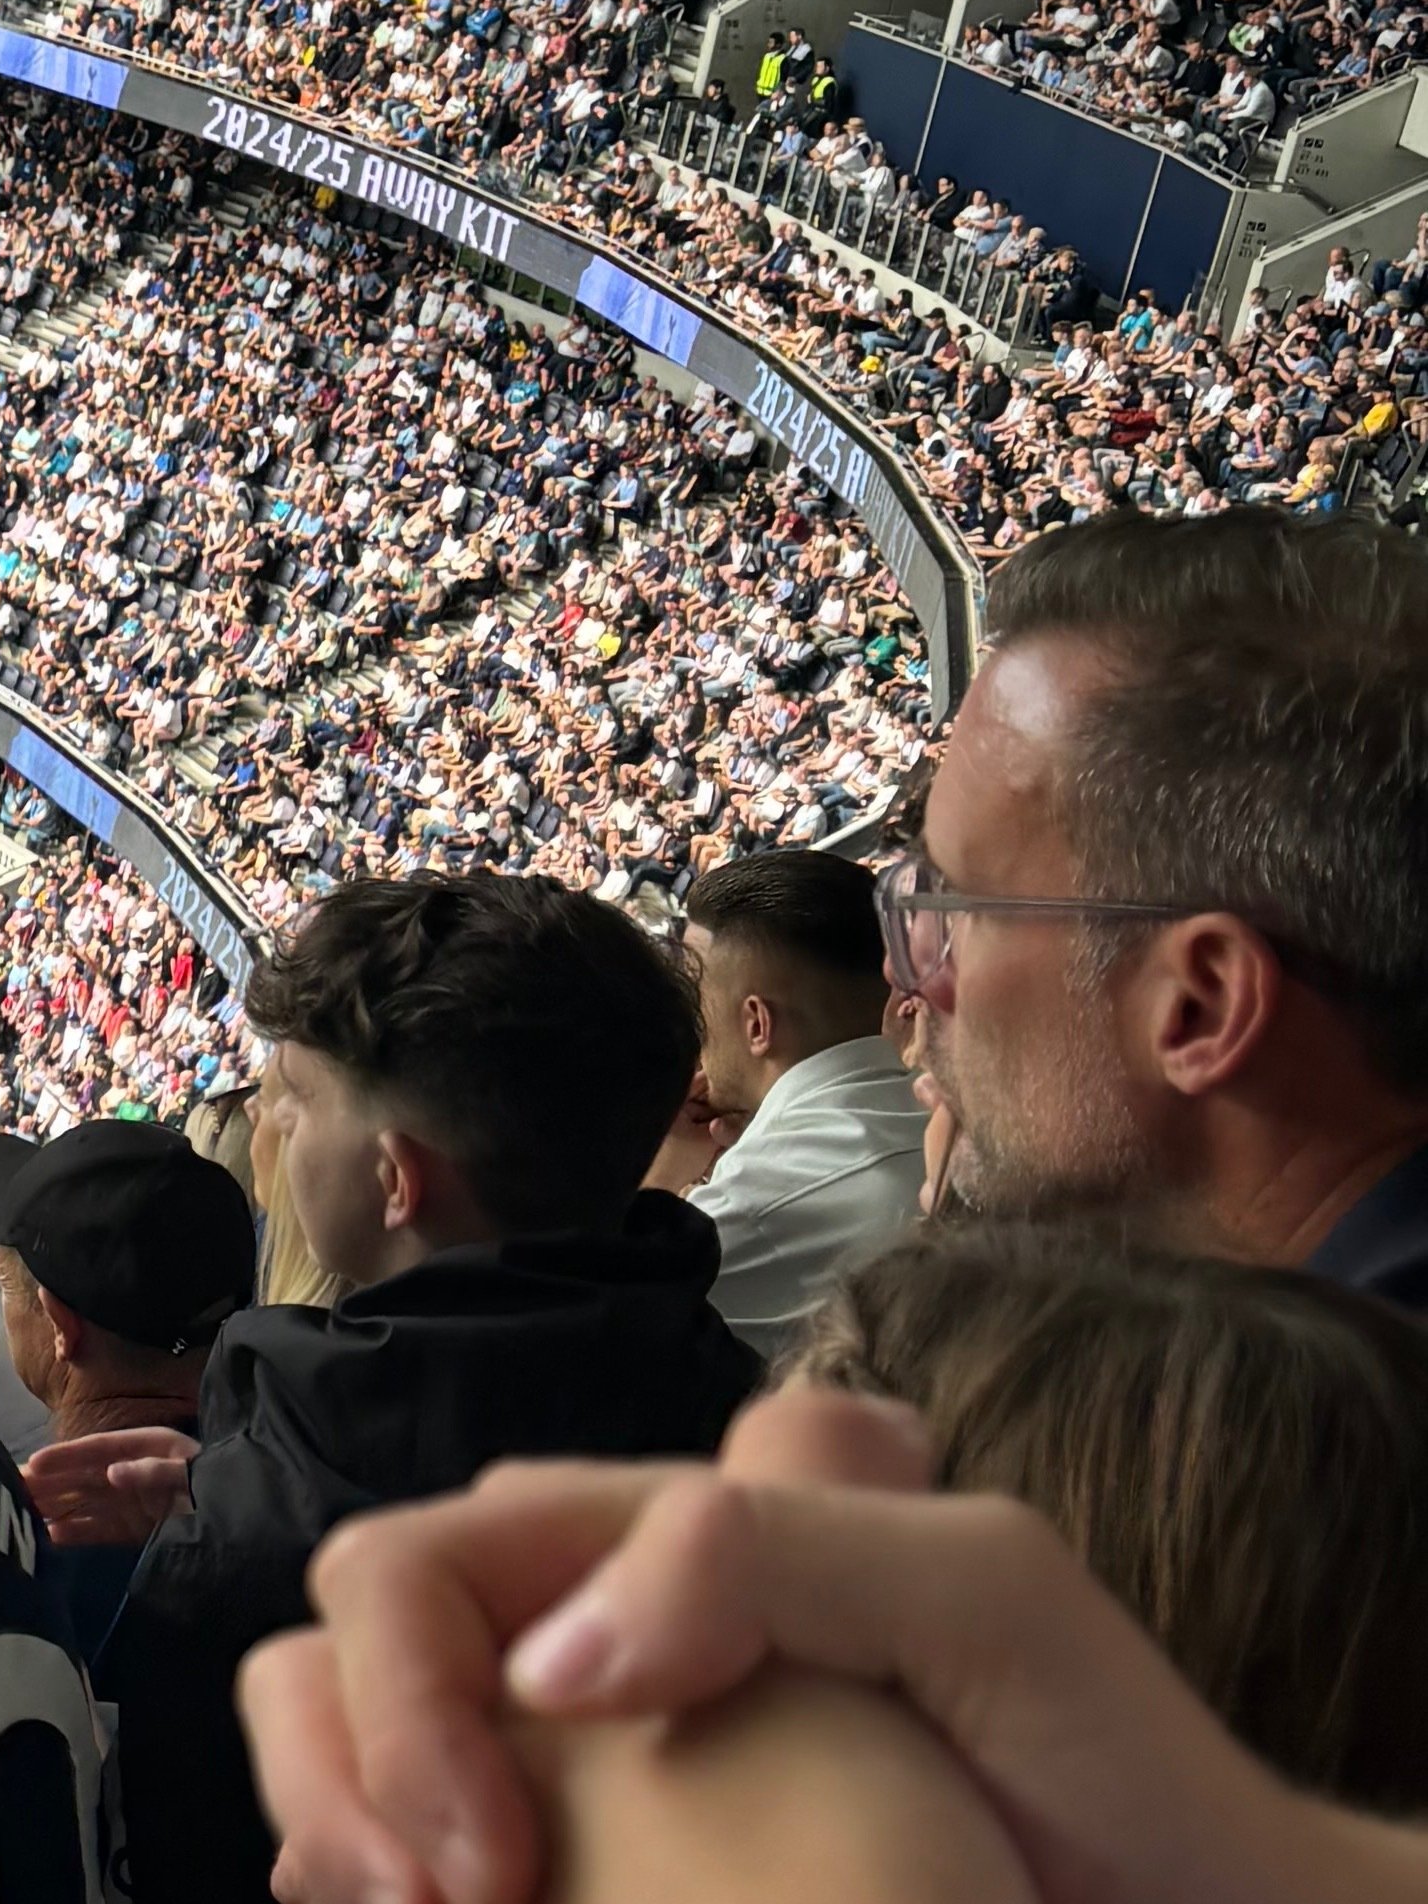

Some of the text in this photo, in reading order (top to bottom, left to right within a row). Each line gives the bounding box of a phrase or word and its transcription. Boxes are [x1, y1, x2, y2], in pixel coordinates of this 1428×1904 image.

[201, 96, 520, 263] 2024/25 AWAY KIT
[746, 360, 847, 485] 2024/25
[159, 854, 241, 986] 2024/25
